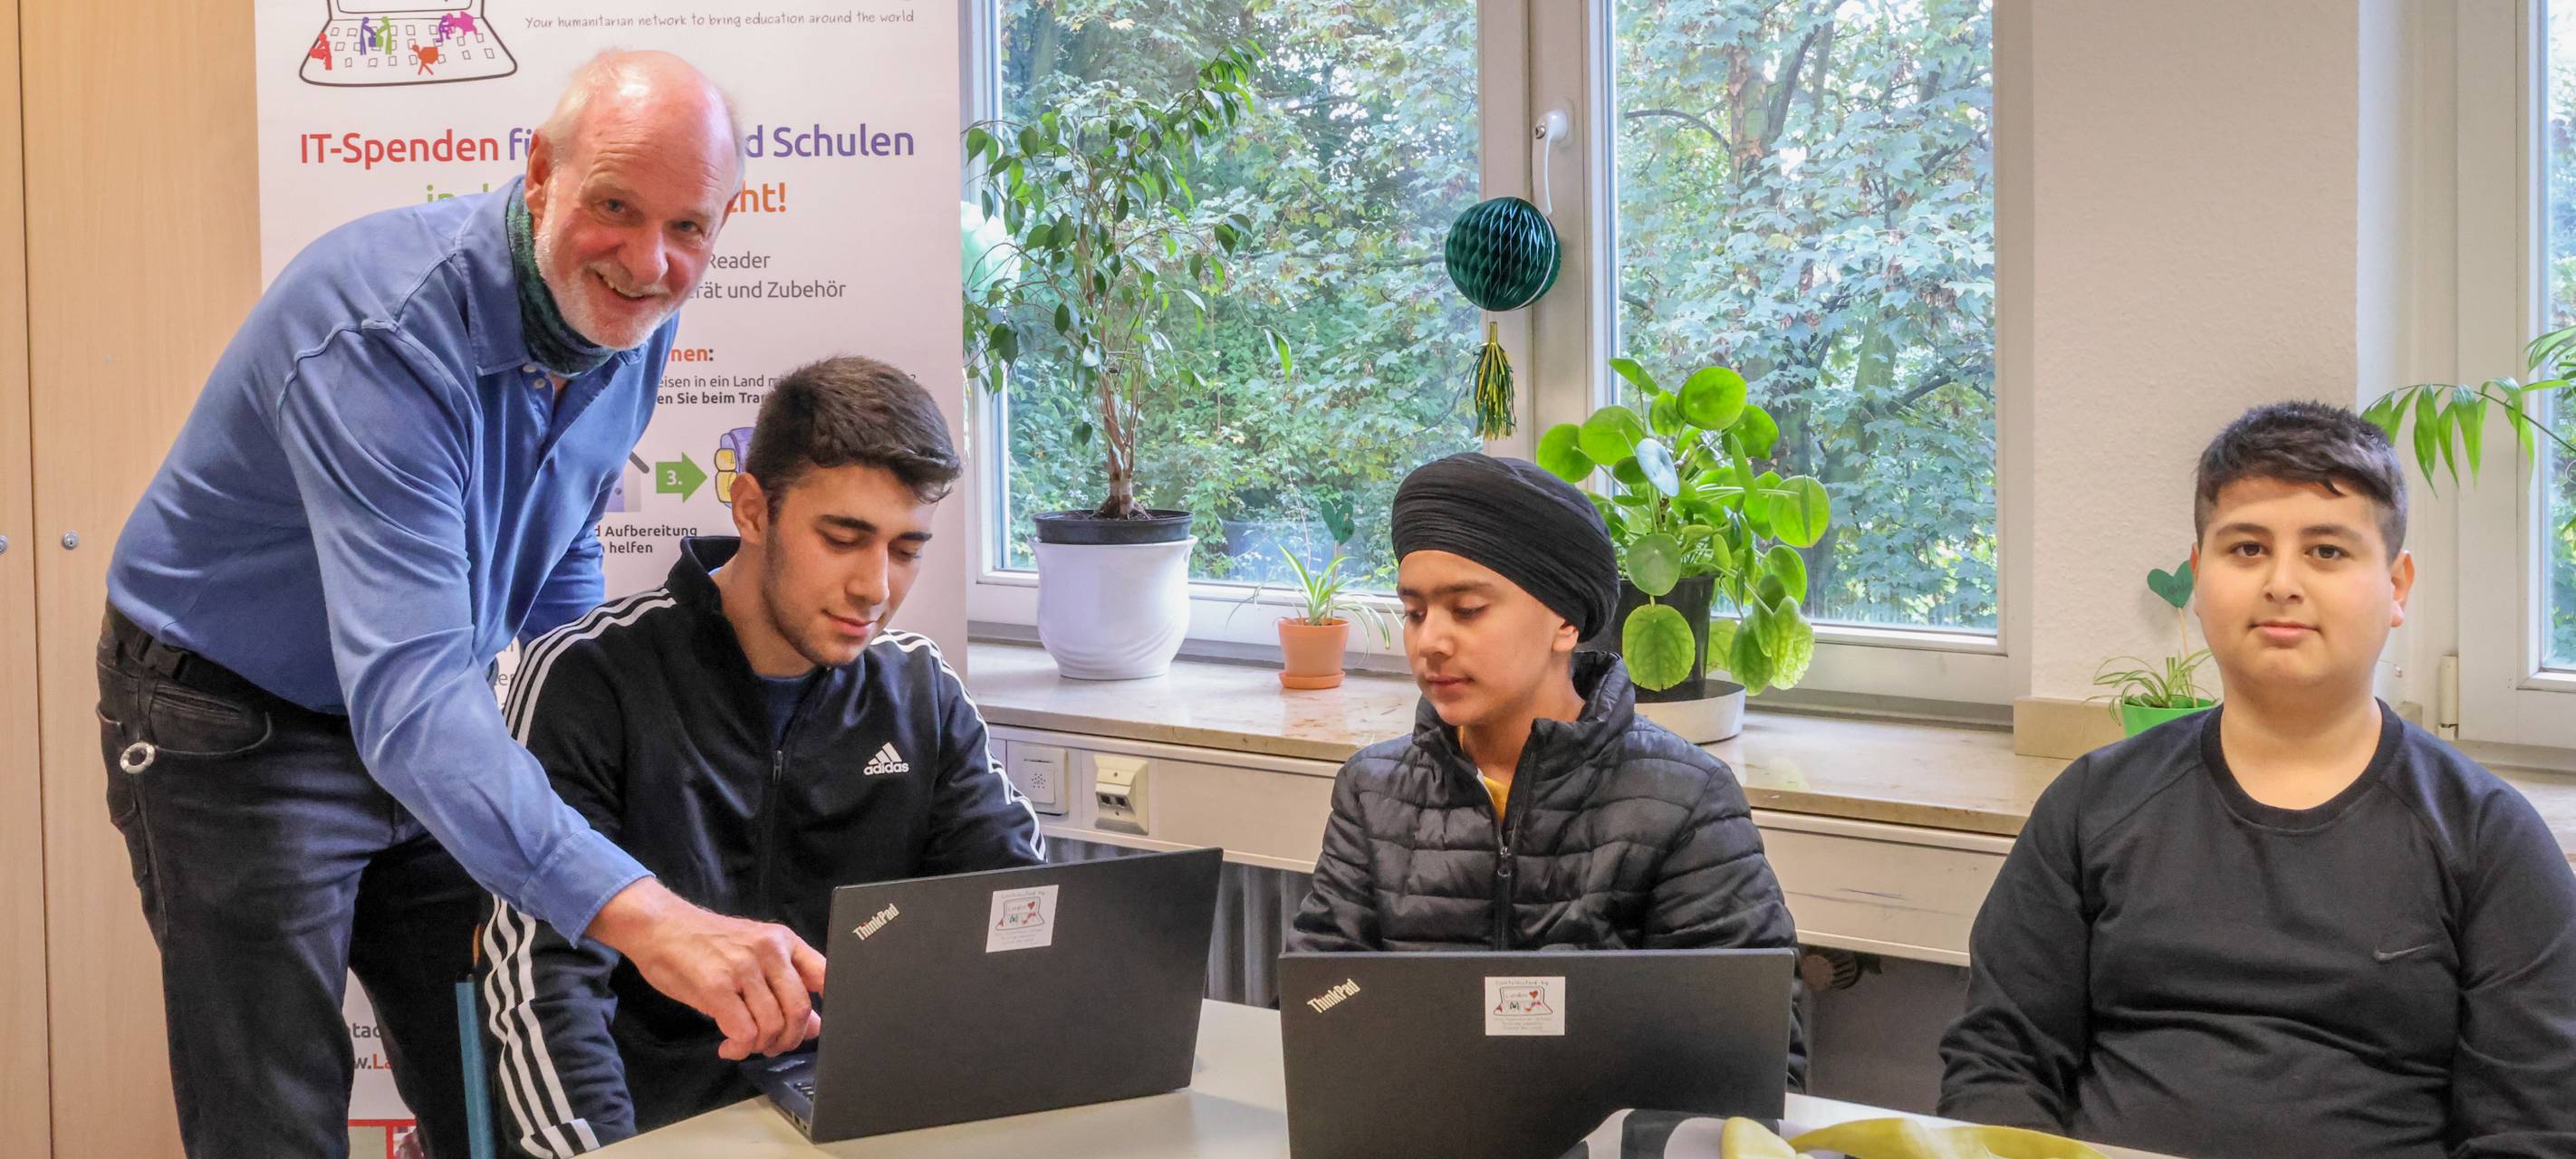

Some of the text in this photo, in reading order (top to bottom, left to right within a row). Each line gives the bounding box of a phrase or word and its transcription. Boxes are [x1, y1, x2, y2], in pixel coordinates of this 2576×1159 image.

[524, 10, 915, 28] Your humanitarian network to bring education around the world
[301, 129, 499, 170] IT-Spenden
[773, 123, 915, 158] Schulen
[730, 181, 787, 214] ht!
[690, 280, 847, 299] rät und Zubehör
[668, 348, 714, 362] nen:
[694, 375, 706, 388] in
[709, 375, 729, 388] ein
[733, 374, 764, 388] Land
[657, 395, 673, 405] en
[677, 392, 697, 405] Sie
[702, 392, 735, 404] beim
[666, 470, 683, 486] 3.
[609, 541, 653, 553] helfen
[863, 762, 909, 776] adidas
[852, 903, 899, 941] ThinkPad
[1307, 978, 1360, 1013] ThinkPad
